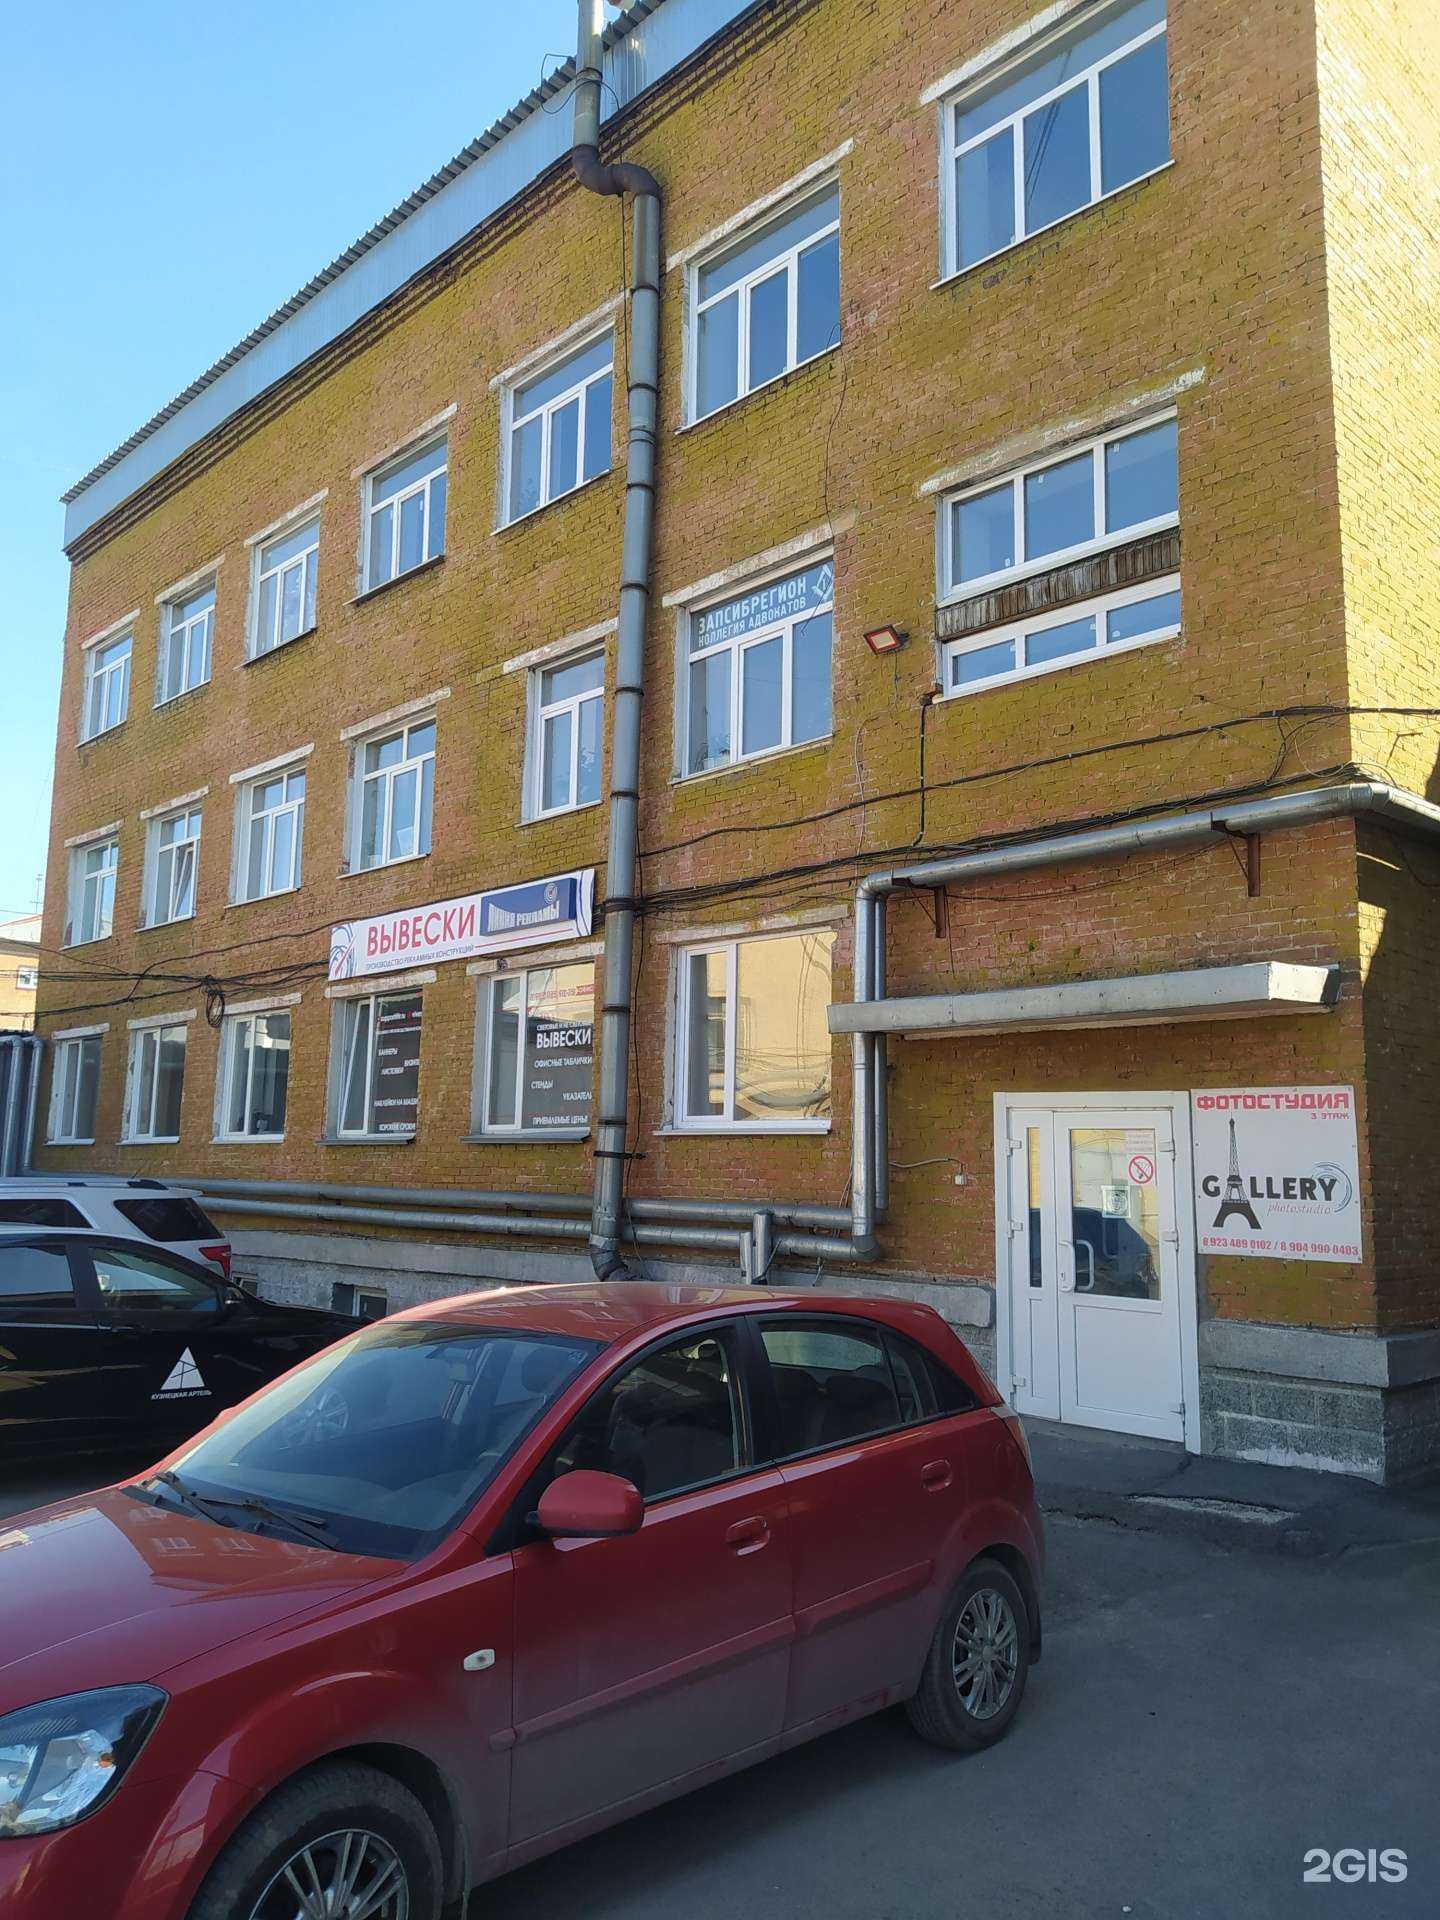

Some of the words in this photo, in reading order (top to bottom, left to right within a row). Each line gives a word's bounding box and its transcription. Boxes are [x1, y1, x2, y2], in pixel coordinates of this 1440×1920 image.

[698, 576, 807, 634] ЗАПСИБРЕГИОН
[698, 621, 746, 648] КОЛЛЕГИЯ
[748, 596, 807, 628] АДВОКАТОВ
[366, 904, 476, 957] ВЫВЕСКИ
[536, 1028, 592, 1049] ВЫВЕСКИ
[1196, 1092, 1350, 1110] ФОТОСТУДИЯ
[1311, 1112, 1317, 1120] 3
[1321, 1112, 1350, 1120] ЭТАЖ
[1266, 1201, 1333, 1217] photostudio
[1209, 1237, 1228, 1248] 923
[1279, 1240, 1287, 1251] 8
